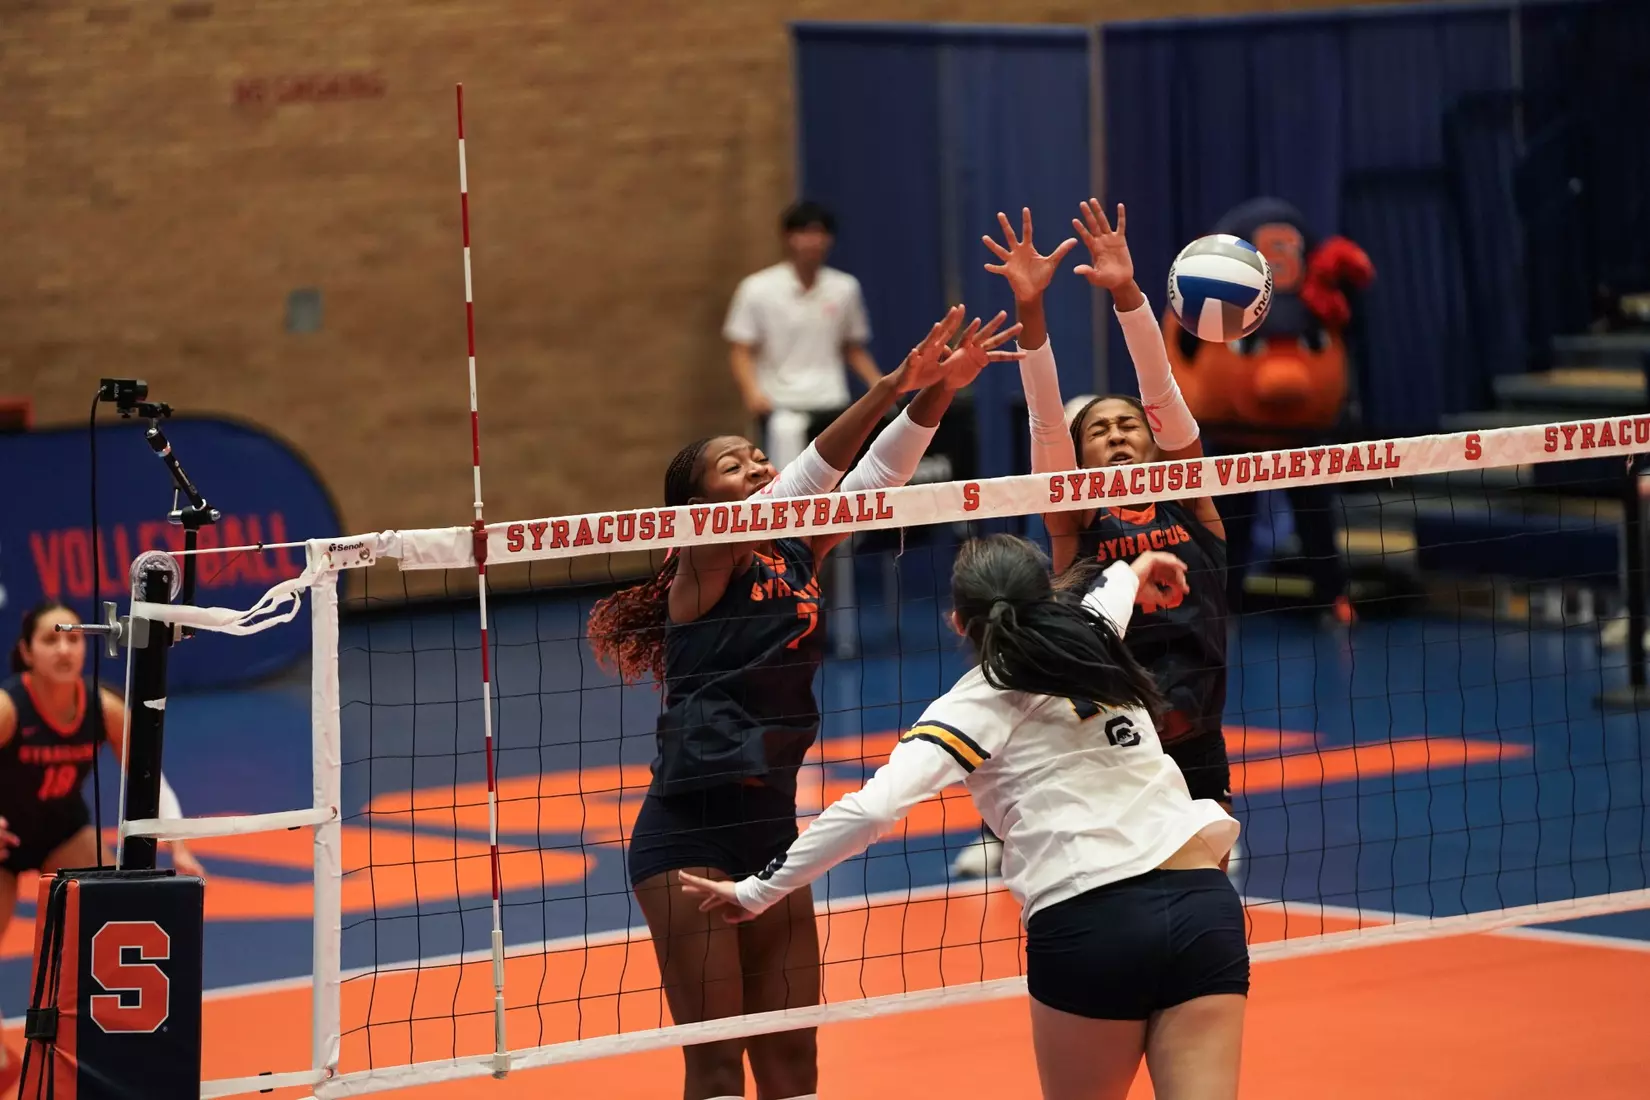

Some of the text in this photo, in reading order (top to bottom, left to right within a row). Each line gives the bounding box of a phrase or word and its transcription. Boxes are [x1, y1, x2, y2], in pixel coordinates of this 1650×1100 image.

[1465, 433, 1482, 461] S
[1049, 442, 1401, 503] SYRACUSE VOLLEYBALL
[963, 483, 980, 511] S
[506, 491, 894, 552] SYRACUSE VOLLEYBALL
[337, 541, 364, 552] Senoh
[786, 602, 818, 649] 7
[18, 743, 101, 763] SYRACUS
[90, 920, 171, 1034] S
